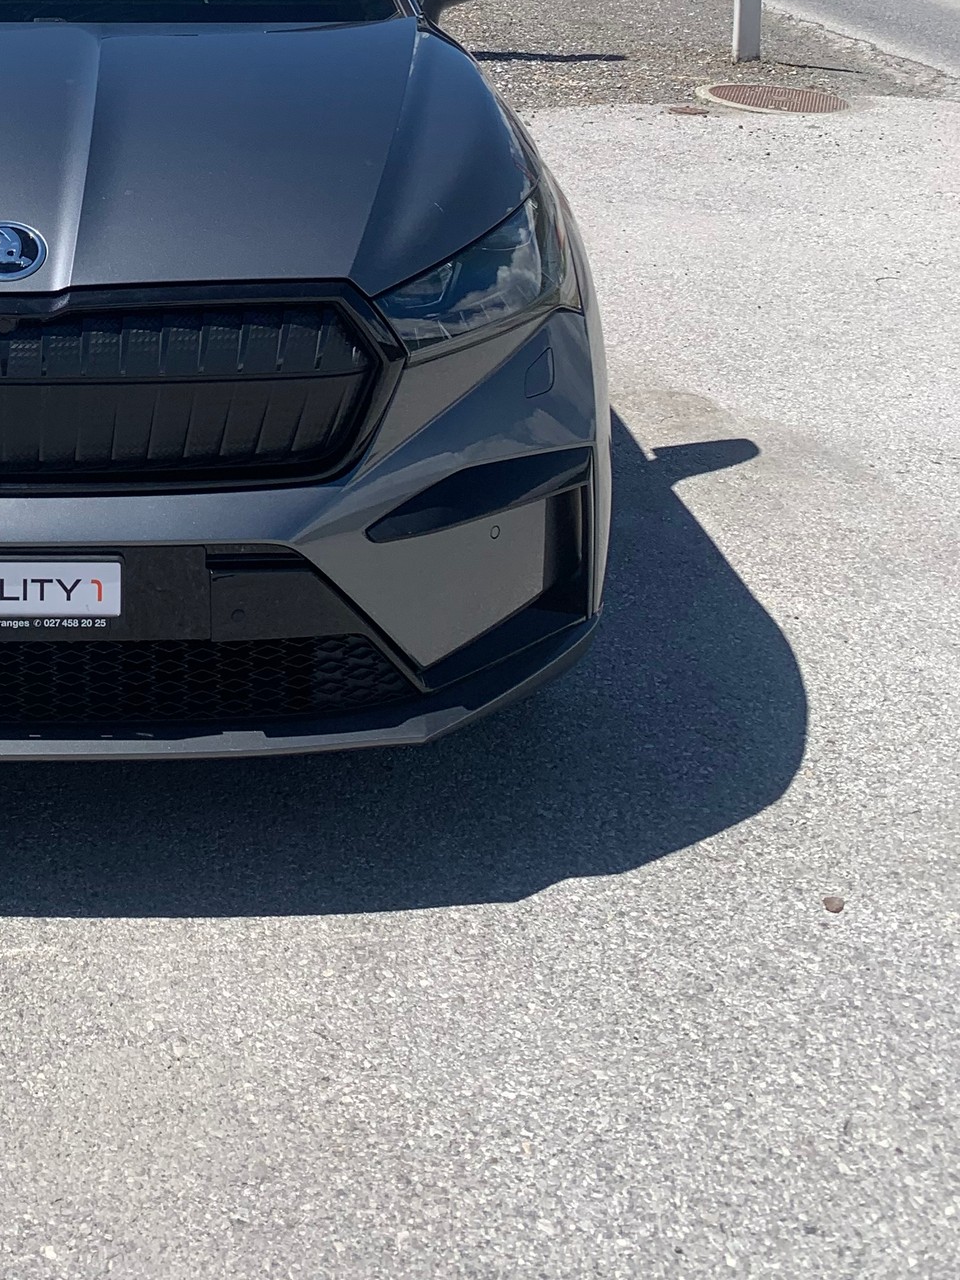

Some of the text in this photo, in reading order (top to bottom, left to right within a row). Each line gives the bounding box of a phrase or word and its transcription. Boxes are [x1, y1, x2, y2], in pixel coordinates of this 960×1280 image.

[43, 619, 61, 628] 027
[62, 619, 79, 628] 458
[80, 619, 93, 628] 20
[95, 619, 107, 628] 25
